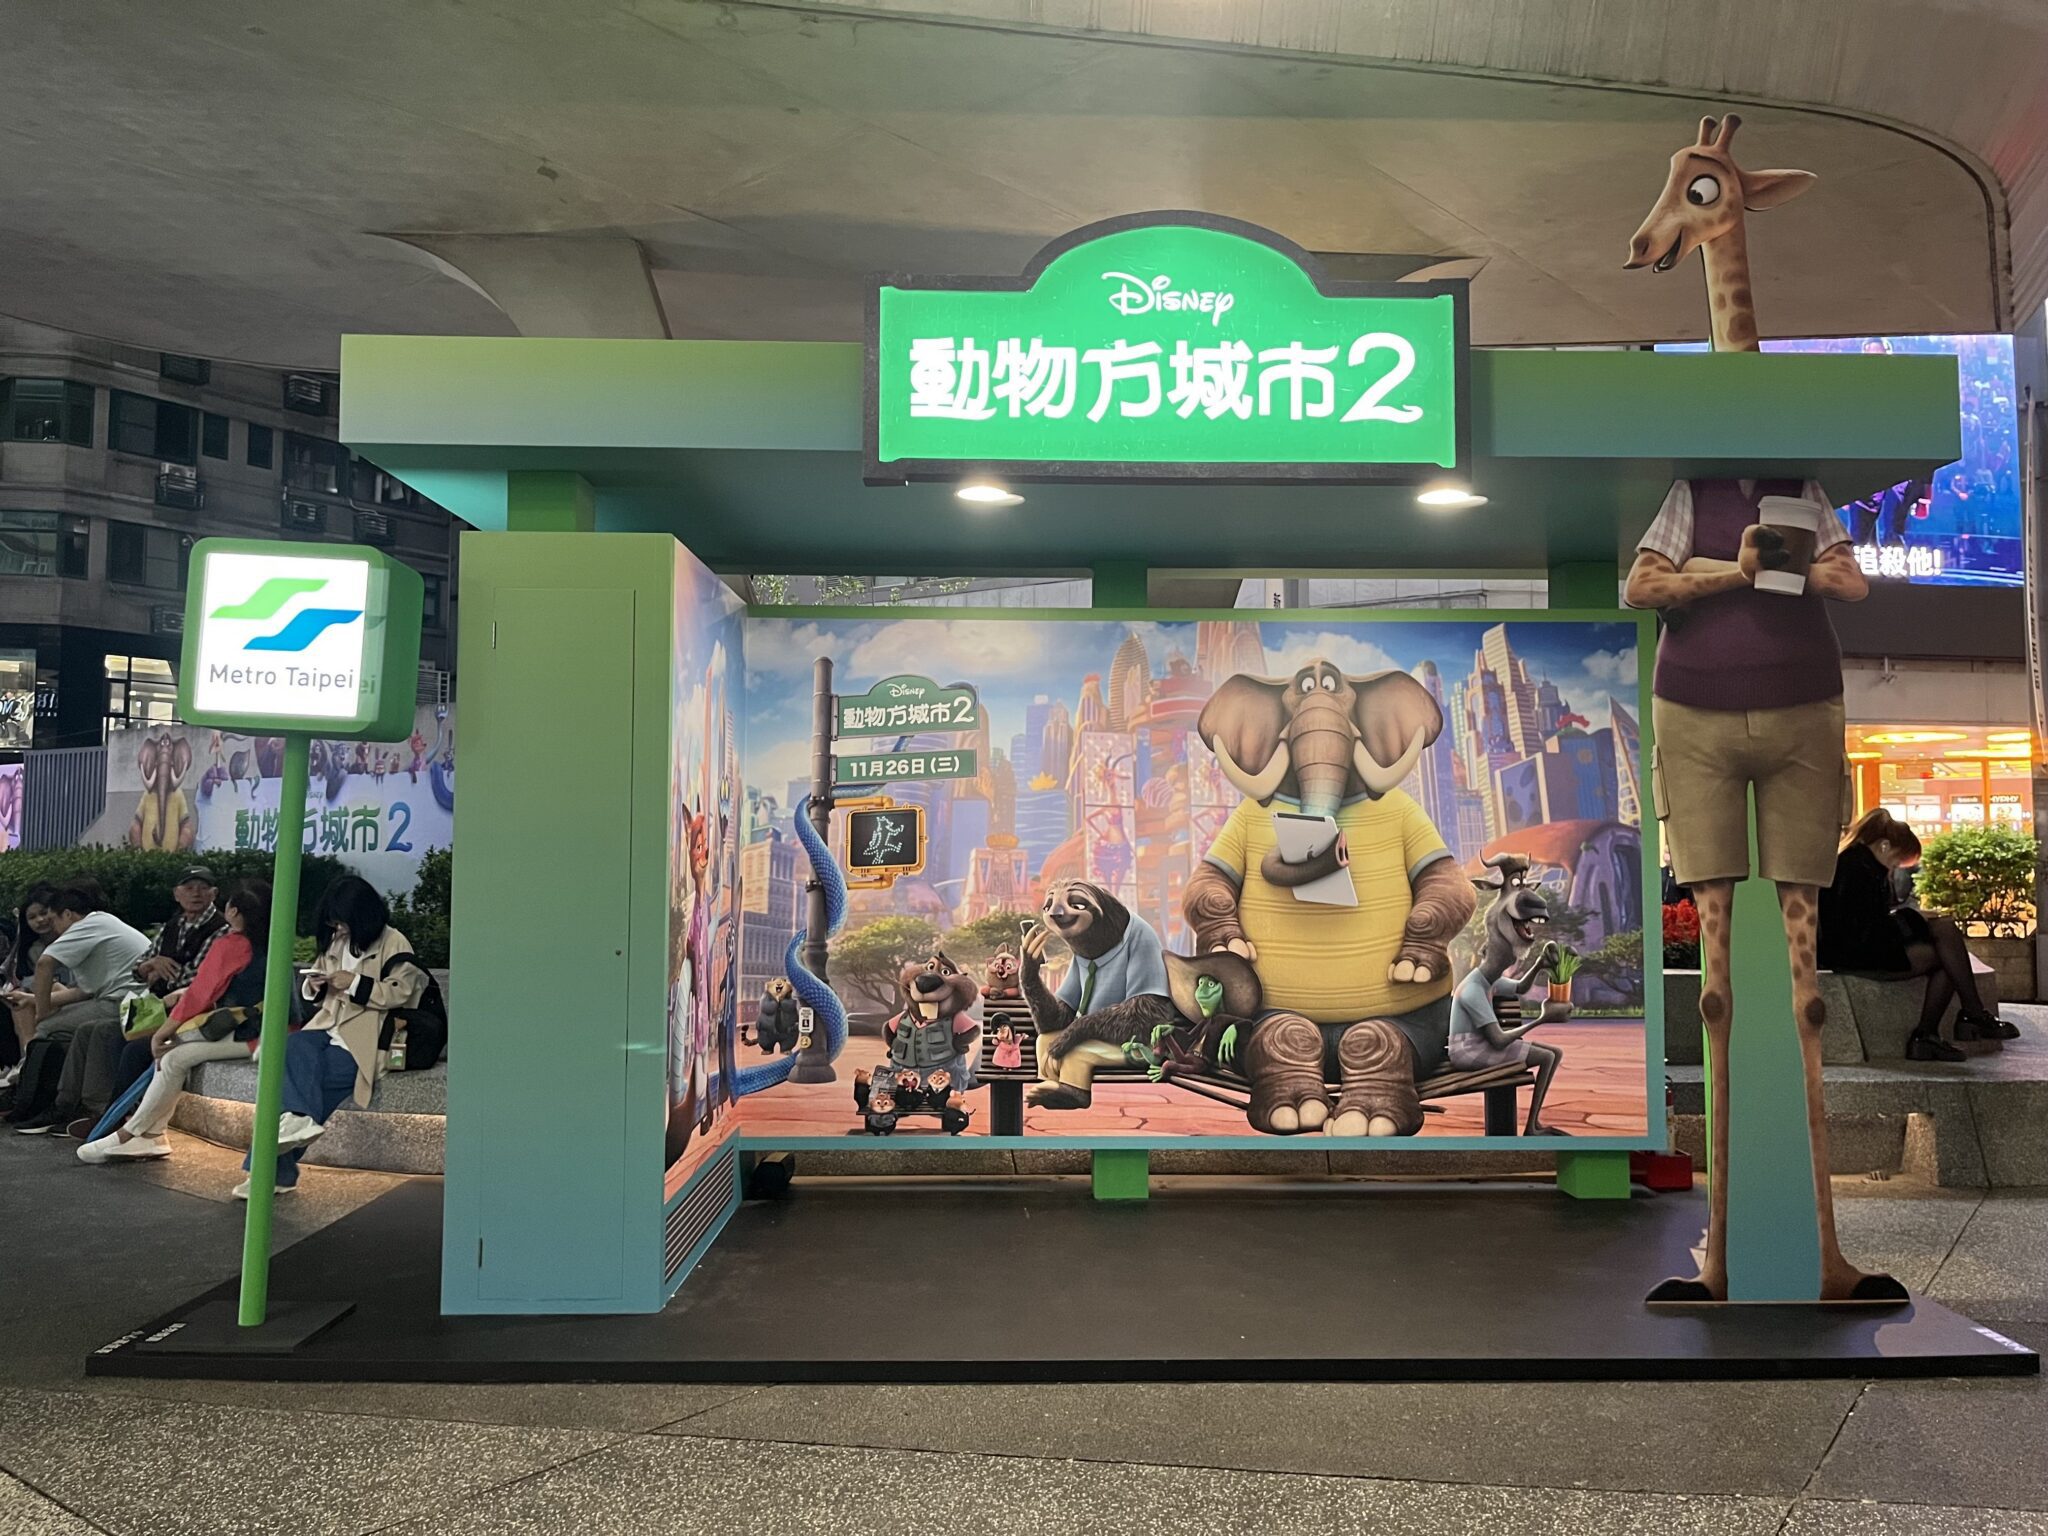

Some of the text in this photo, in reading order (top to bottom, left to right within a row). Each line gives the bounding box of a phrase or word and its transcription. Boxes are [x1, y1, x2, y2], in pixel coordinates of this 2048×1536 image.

[1101, 271, 1234, 326] Disney
[909, 332, 1424, 424] 動物方城市2
[209, 663, 277, 685] Metro
[285, 666, 354, 693] Taipei
[886, 683, 926, 699] Disney
[843, 696, 975, 729] 動物方城市2
